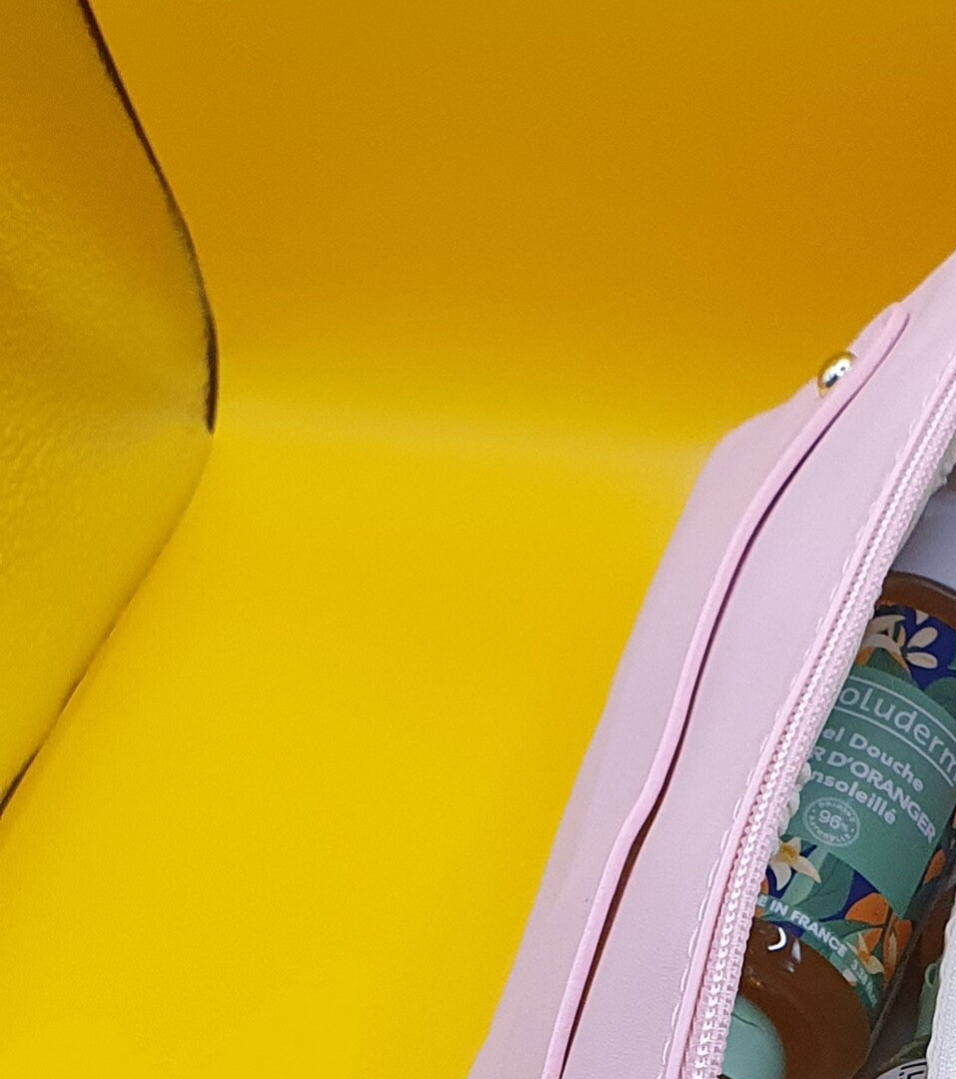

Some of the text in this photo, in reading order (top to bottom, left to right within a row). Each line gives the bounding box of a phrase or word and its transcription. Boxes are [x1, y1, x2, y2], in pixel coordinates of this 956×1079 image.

[848, 732, 924, 794] Douche
[827, 750, 937, 845] D'ORANGER
[769, 900, 789, 916] IN
[790, 910, 848, 957] FRANCE
